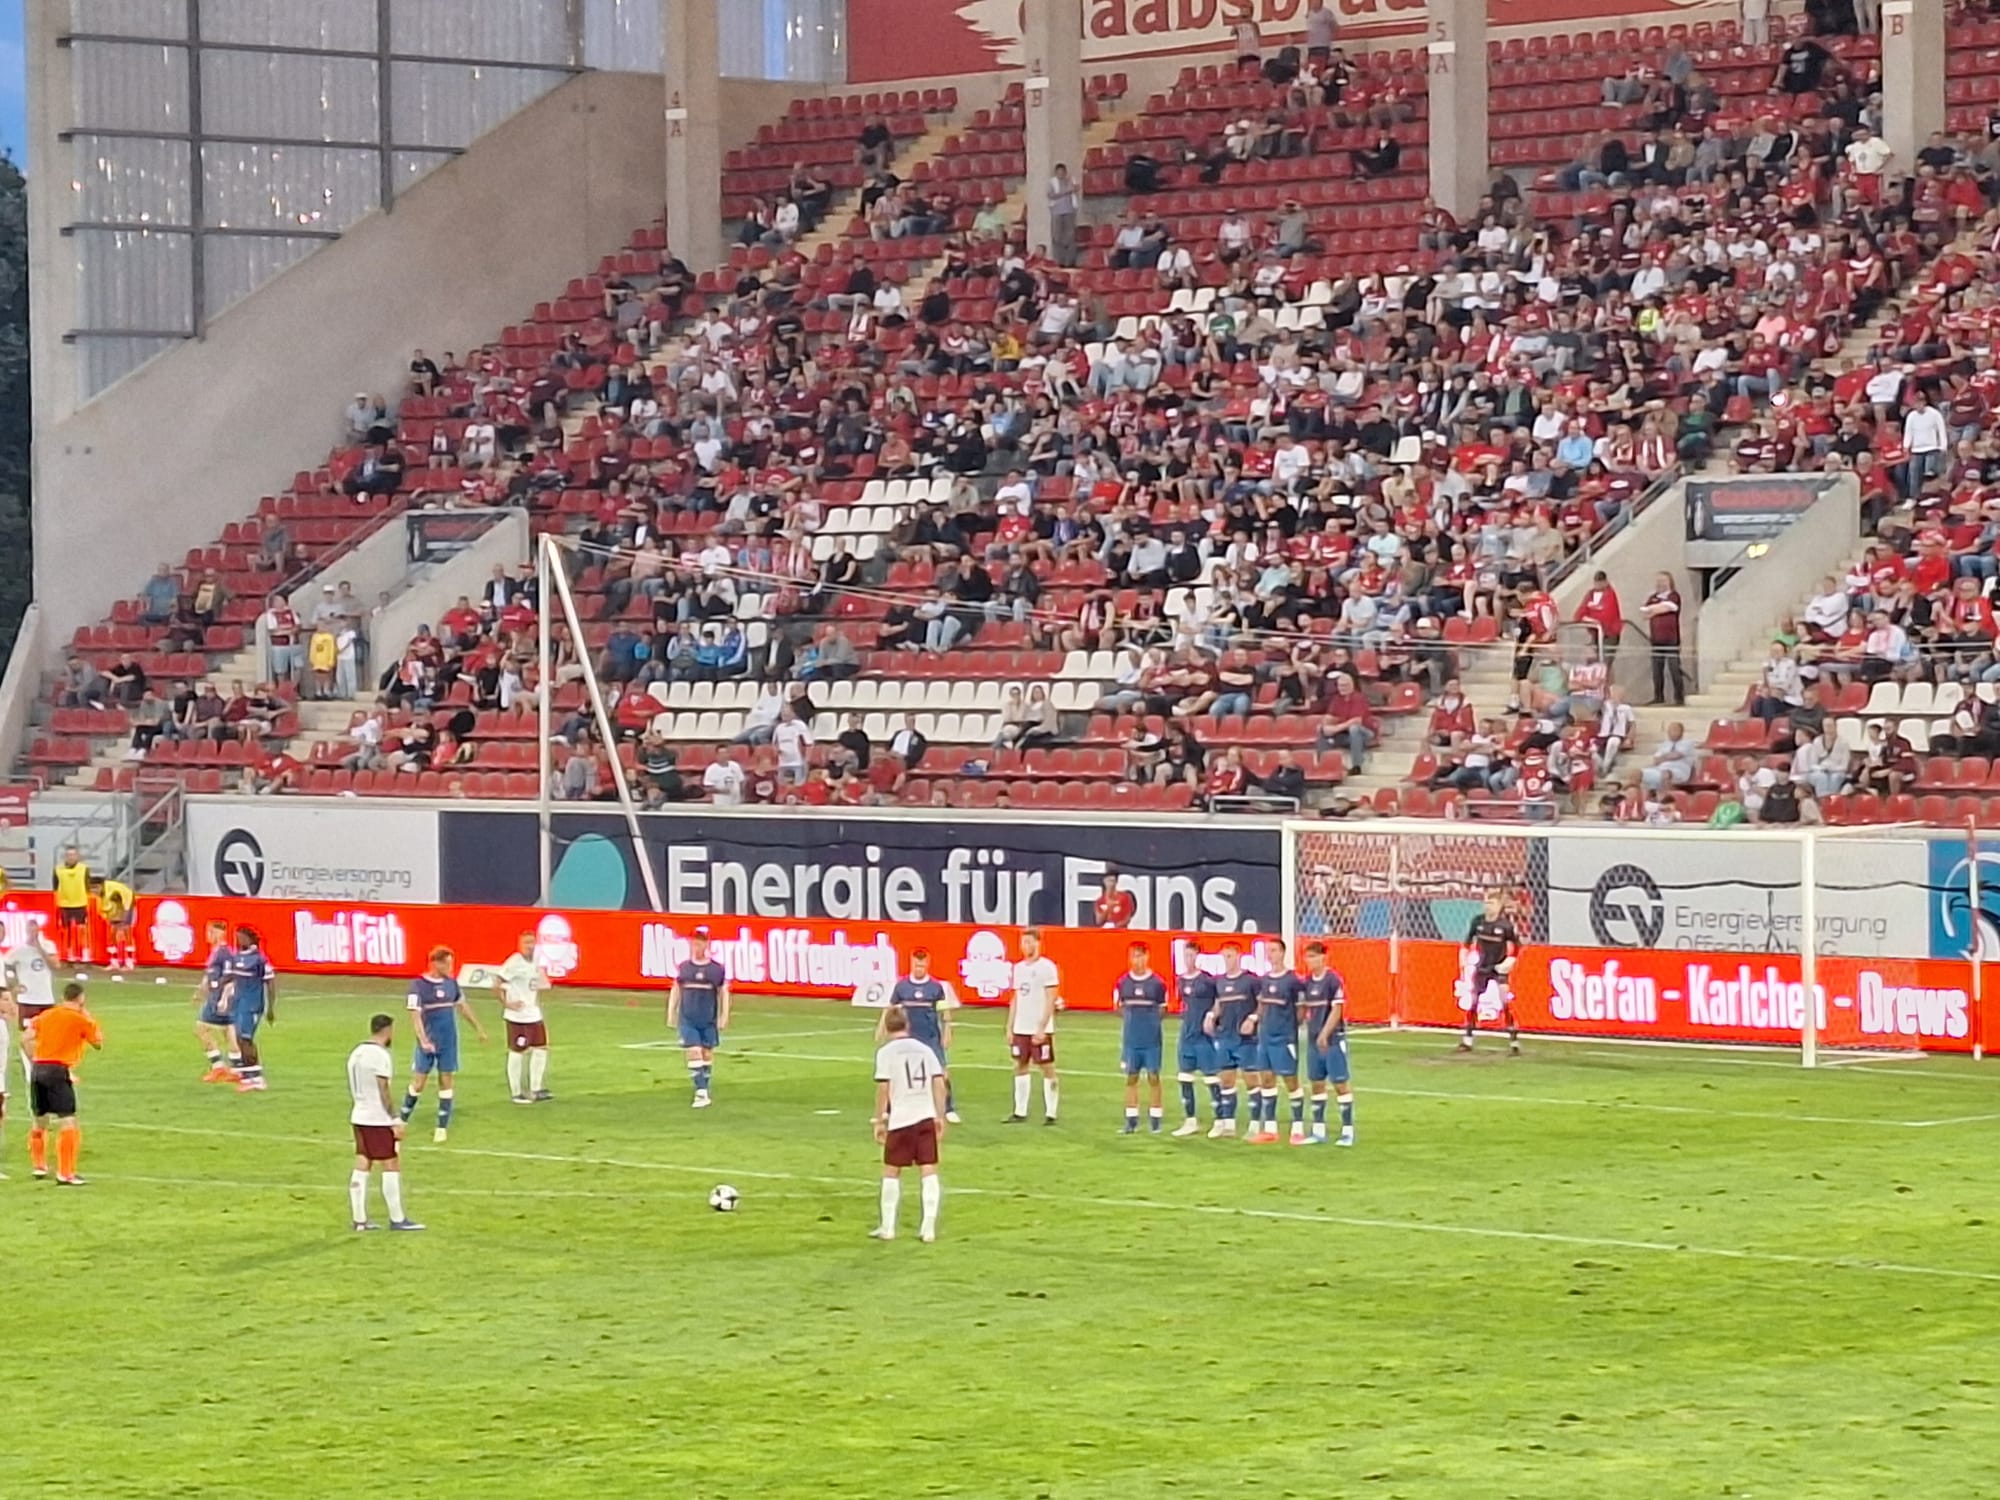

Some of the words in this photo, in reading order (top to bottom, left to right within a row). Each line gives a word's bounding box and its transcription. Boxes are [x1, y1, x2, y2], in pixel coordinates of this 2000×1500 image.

[1891, 15, 1904, 35] B
[1434, 54, 1448, 74] A
[271, 861, 411, 888] Energieversorgung
[942, 848, 1043, 926] für
[694, 926, 766, 982] arde
[1550, 958, 1657, 1023] Stefan
[1688, 964, 1827, 1030] Karlchen
[1859, 971, 1969, 1038] Drews
[904, 1058, 927, 1089] 14
